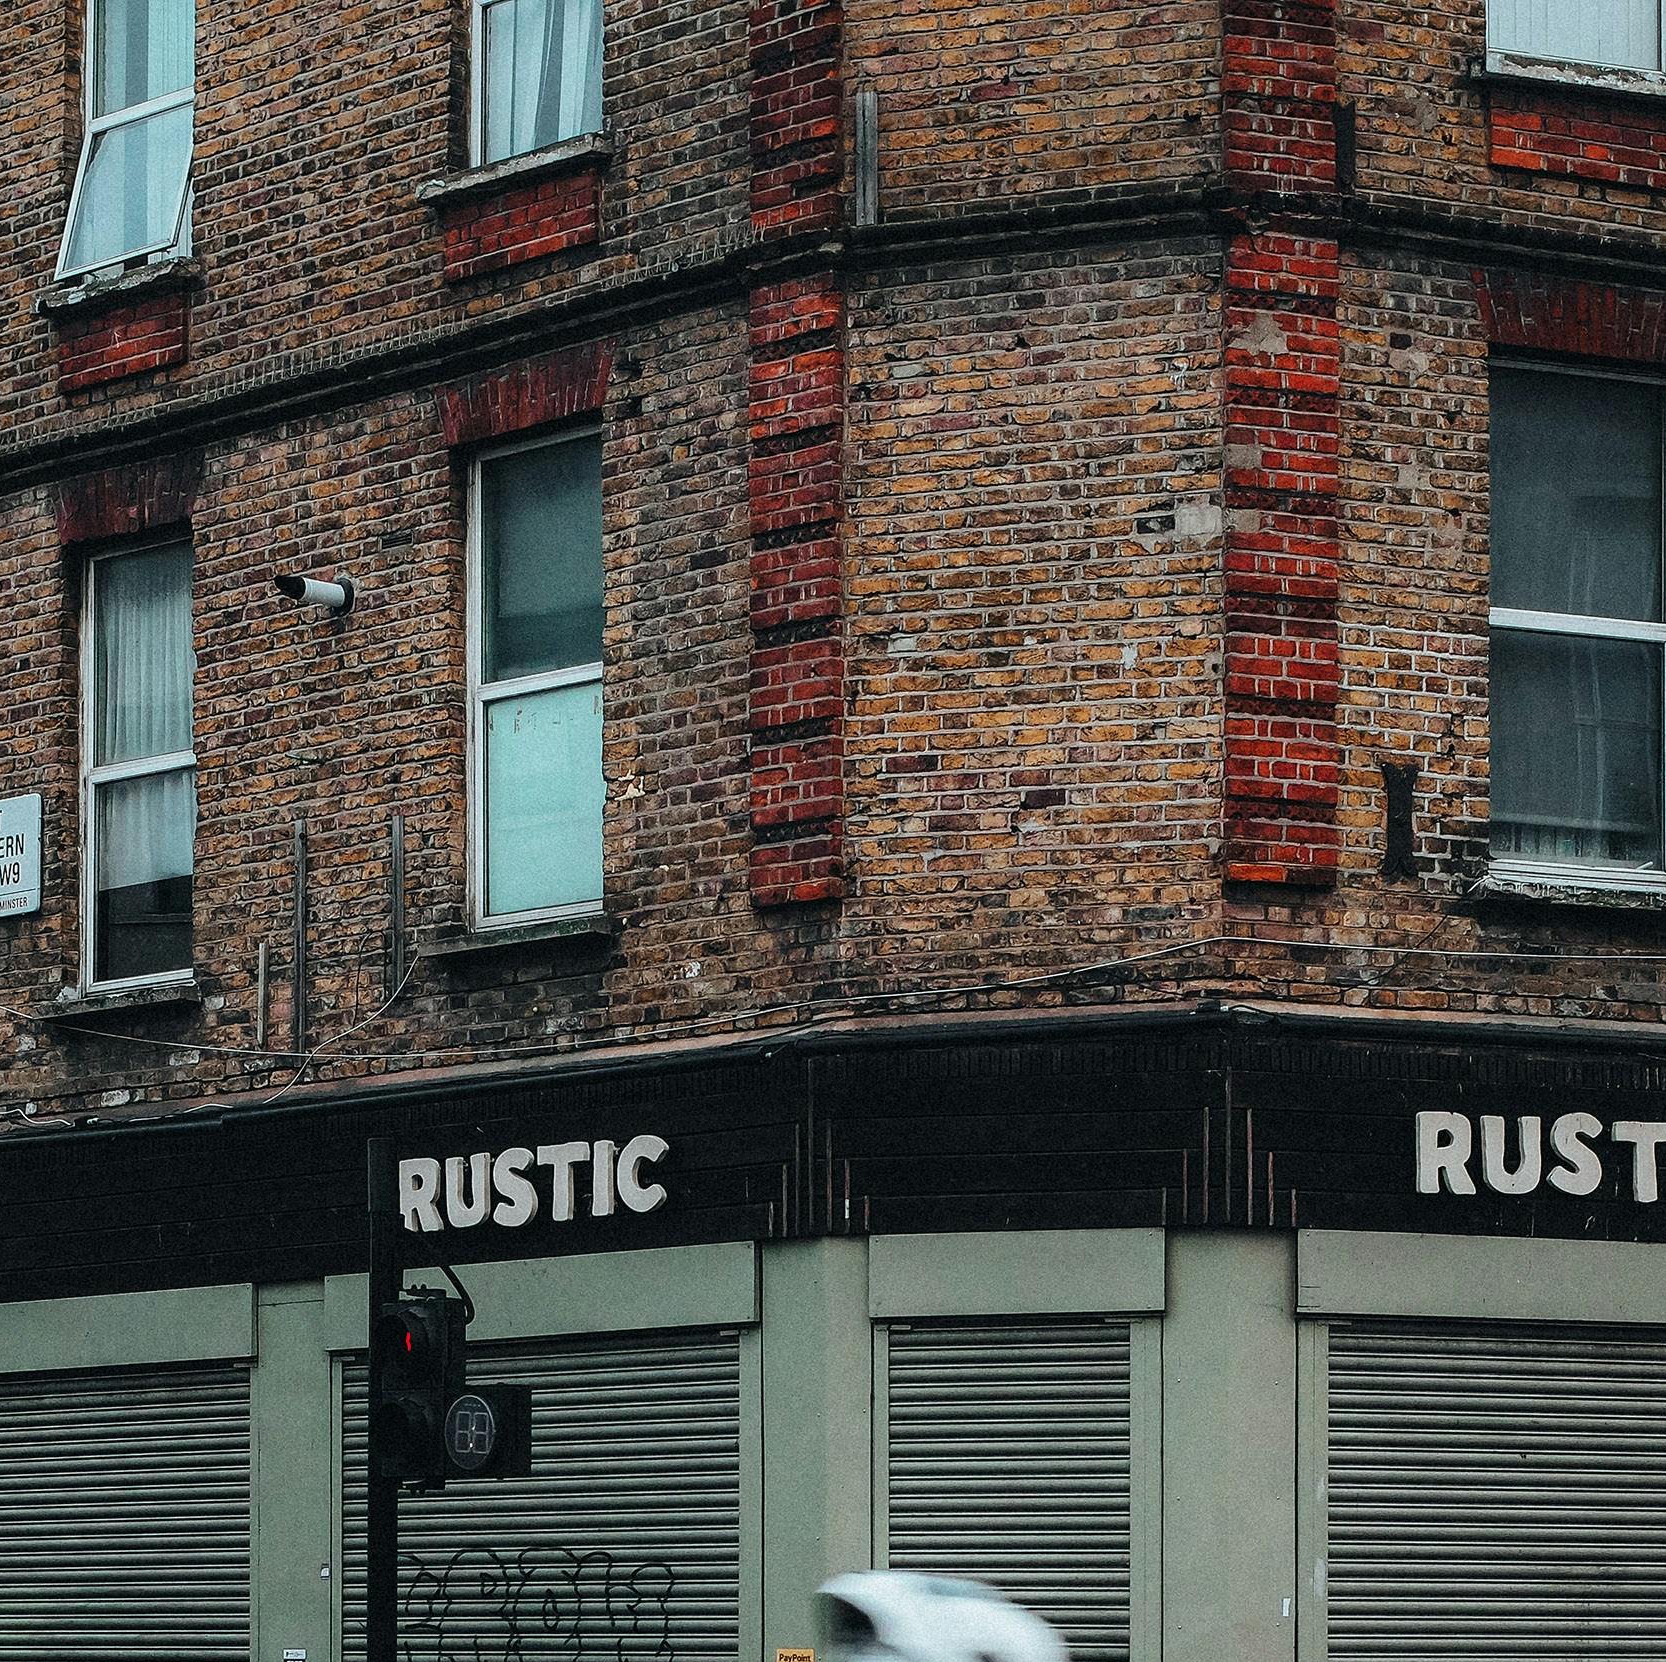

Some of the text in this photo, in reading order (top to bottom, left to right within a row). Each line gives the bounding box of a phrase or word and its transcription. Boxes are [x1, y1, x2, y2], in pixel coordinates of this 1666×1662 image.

[0, 862, 20, 886] W9
[399, 1135, 669, 1232] RUSTIC
[779, 1654, 811, 1662] PayPoint
